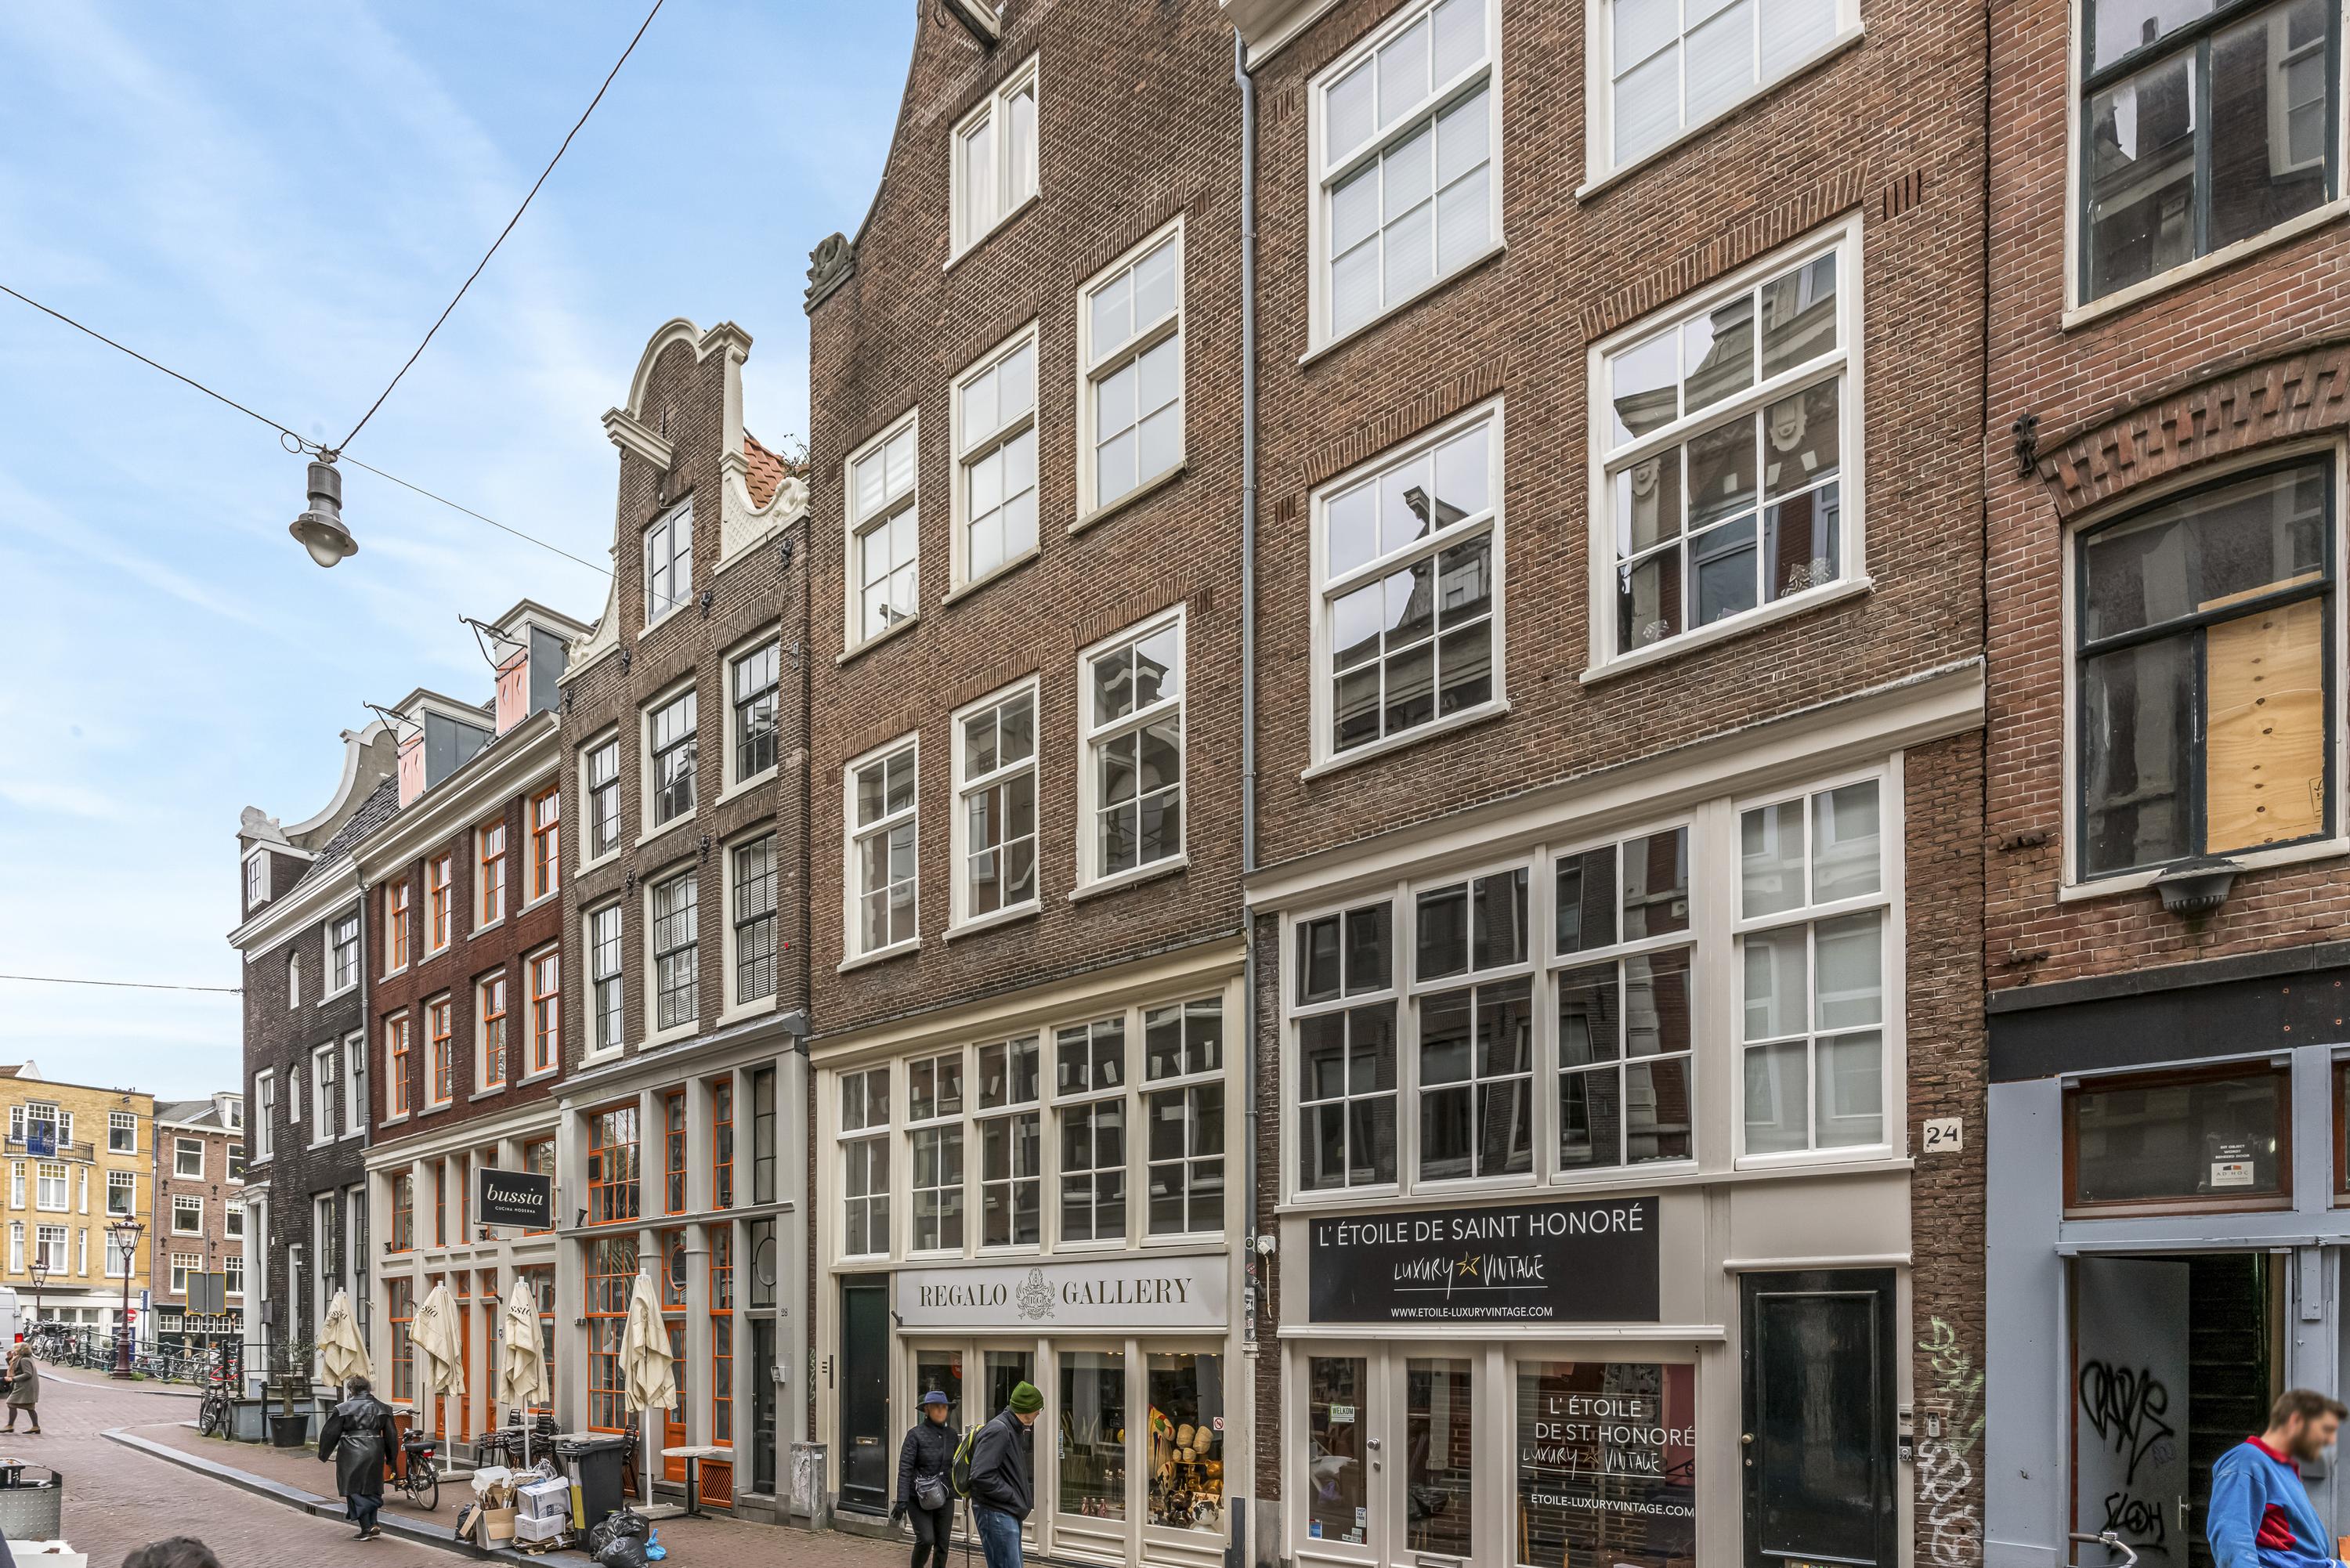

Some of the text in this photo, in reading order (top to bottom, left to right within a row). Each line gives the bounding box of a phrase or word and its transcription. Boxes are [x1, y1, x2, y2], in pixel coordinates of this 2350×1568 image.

[1927, 1125, 1958, 1144] 24
[486, 1183, 544, 1206] bussia
[1415, 1219, 1444, 1242] DE
[1452, 1215, 1521, 1241] SAINT
[1530, 1202, 1643, 1237] HONORÉ
[1394, 1253, 1545, 1301] LUXURY VINTAGE
[917, 1277, 1193, 1307] REGALO GALLERY
[781, 1308, 788, 1317] 28
[1390, 1306, 1553, 1318] WWW.ETOILE-LUXURYVINTAGE.COM
[1332, 1407, 1354, 1415] WELKOM
[1535, 1422, 1695, 1447] DE ST. HONORÉ
[1523, 1445, 1661, 1481] LUXURY VINTAGE
[1531, 1494, 1695, 1518] ETOILE-LUXURYVINTAGE.COM
